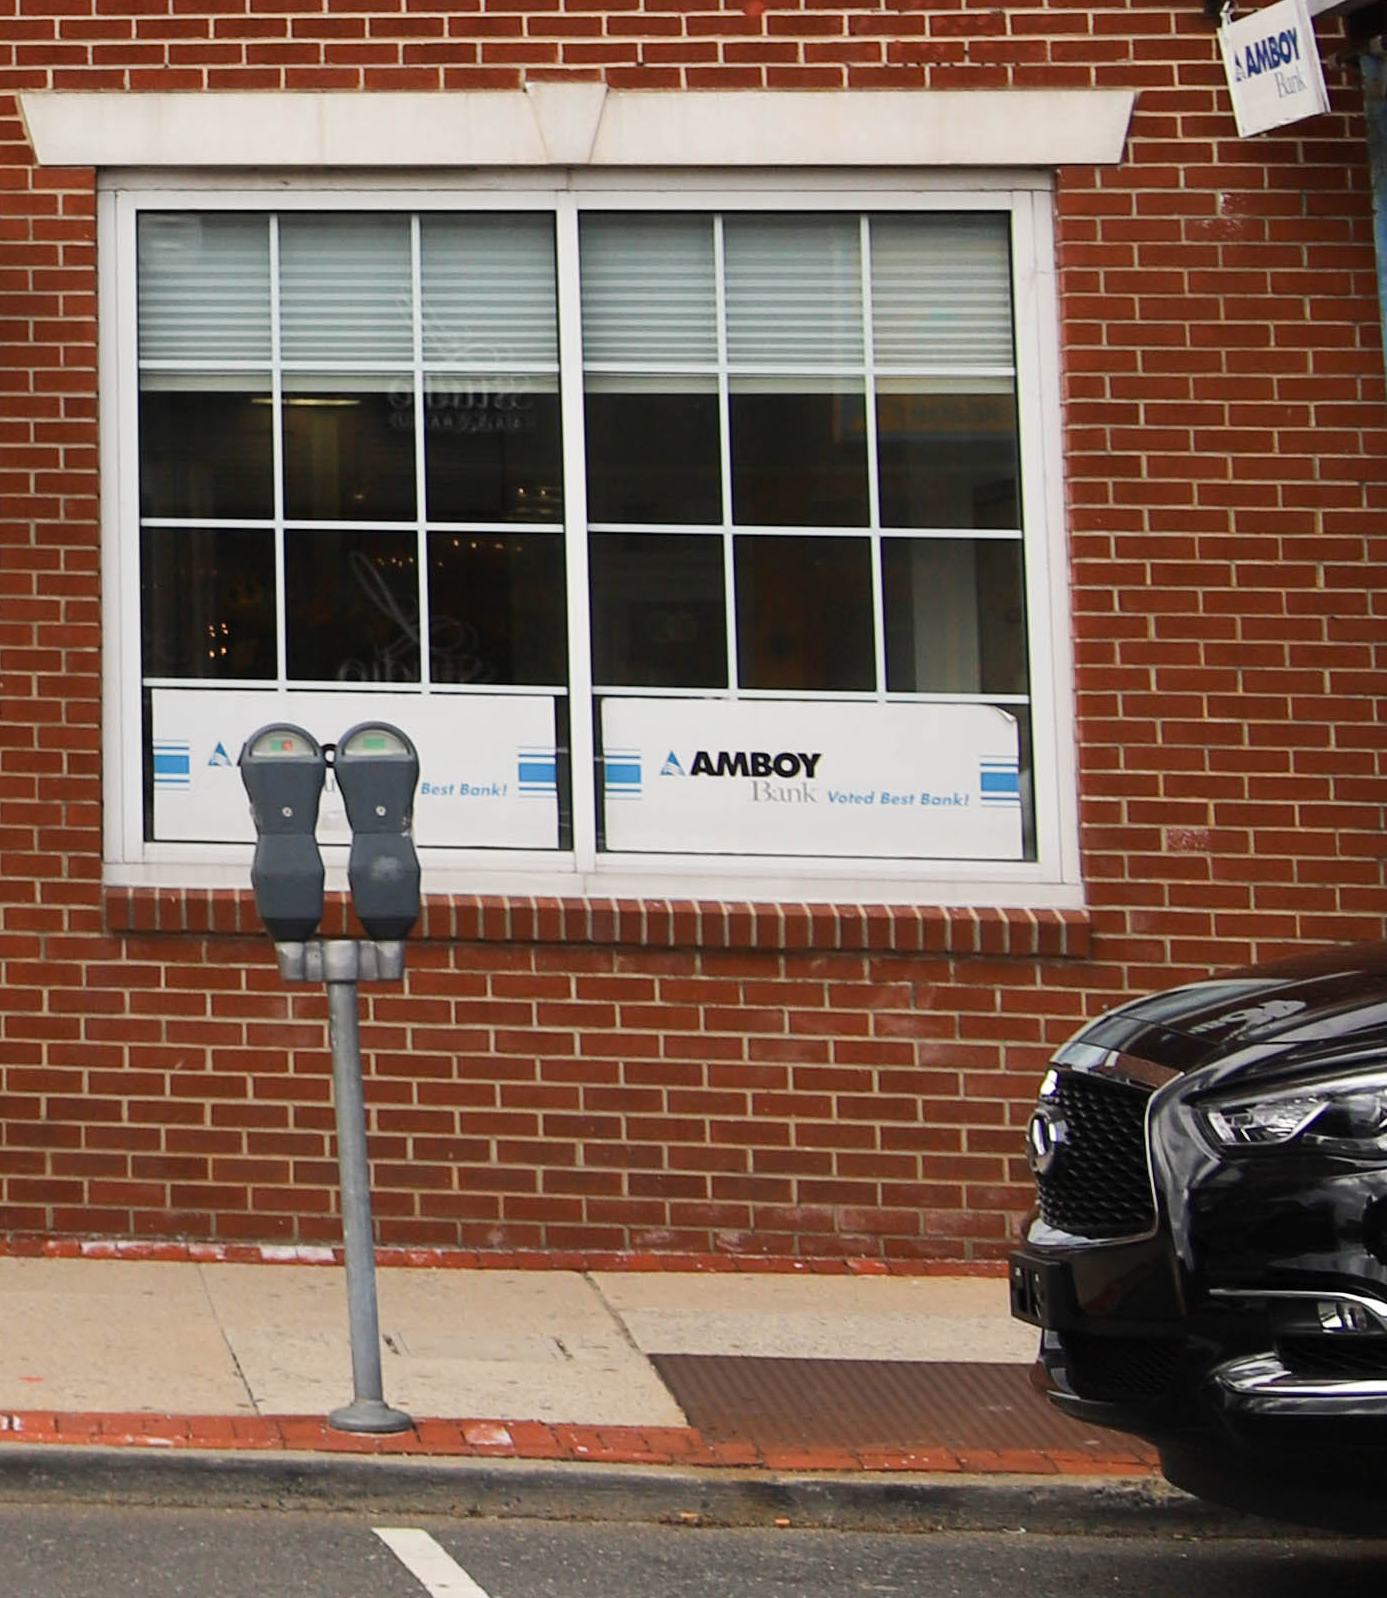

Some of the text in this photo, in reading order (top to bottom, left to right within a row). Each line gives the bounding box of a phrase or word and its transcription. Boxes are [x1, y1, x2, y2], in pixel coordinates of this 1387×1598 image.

[1245, 27, 1300, 77] AMBOY
[1274, 66, 1307, 99] Bank
[690, 750, 823, 779] AMBOY
[421, 781, 509, 797] Best Bank!
[751, 779, 818, 805] Bank
[827, 789, 971, 807] Voted Best Bank!
